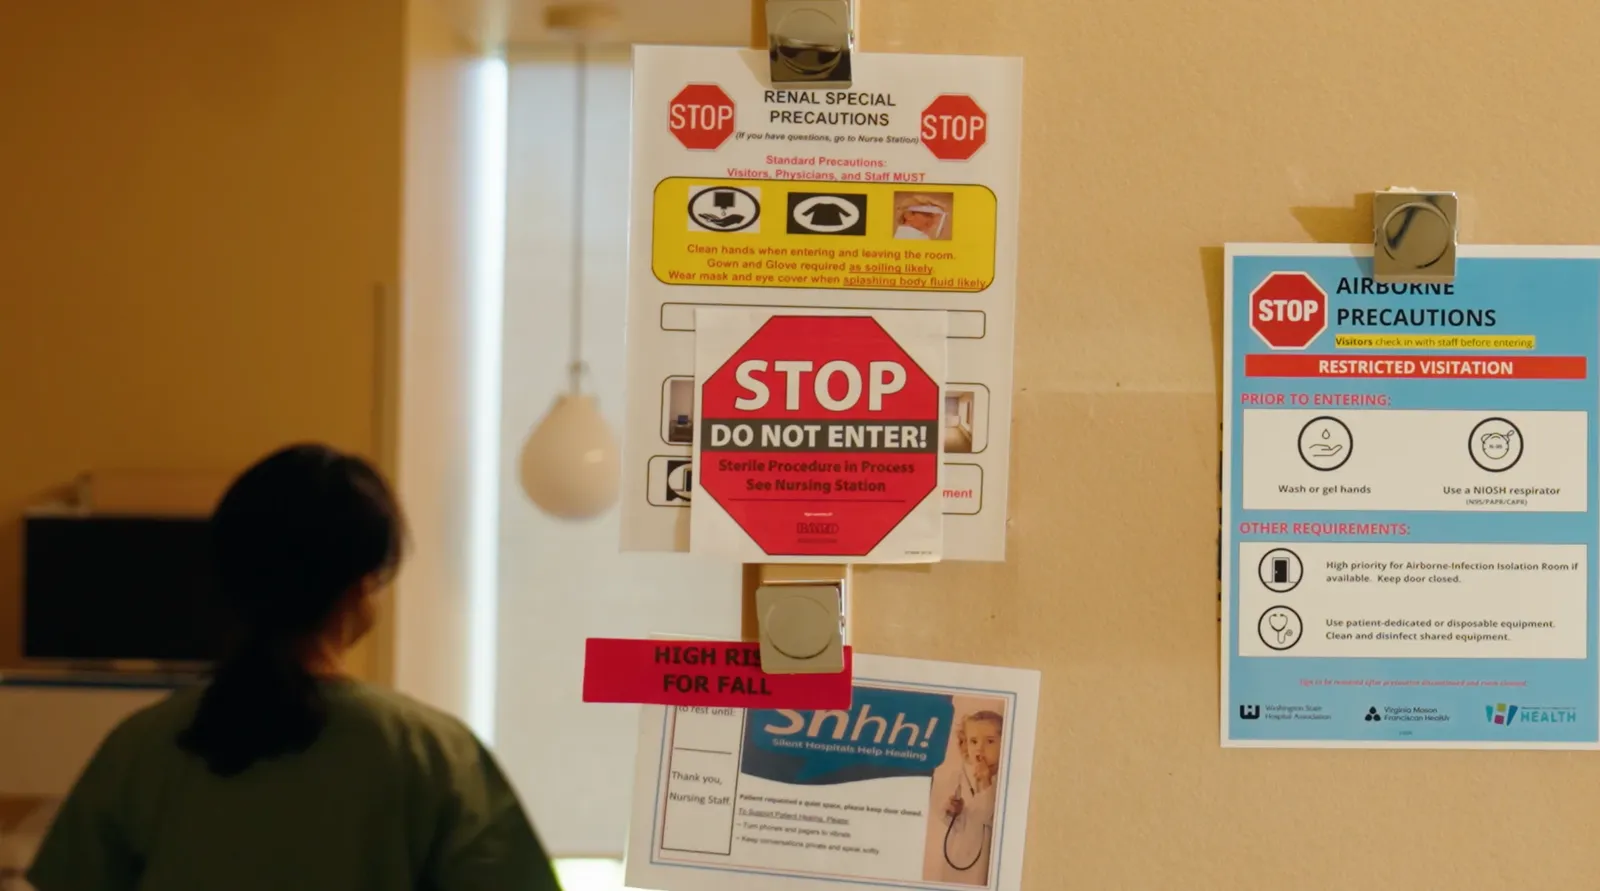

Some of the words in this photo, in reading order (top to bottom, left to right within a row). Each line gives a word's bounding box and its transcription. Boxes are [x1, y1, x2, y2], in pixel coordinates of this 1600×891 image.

[764, 90, 819, 105] RENAL
[825, 92, 896, 106] SPECIAL
[670, 104, 734, 130] STOP
[770, 110, 889, 126] PRECAUTIONS
[922, 114, 985, 141] STOP
[736, 132, 745, 140] (If
[764, 132, 785, 140] have
[788, 133, 832, 142] questions,
[858, 135, 884, 143] Nurse
[886, 135, 919, 144] Station)
[766, 156, 815, 166] Standard
[819, 156, 887, 168] Precautions:
[727, 168, 772, 179] Visitors,
[776, 169, 838, 181] Physicians,
[841, 172, 860, 181] and
[864, 172, 890, 181] Staff
[894, 172, 926, 182] MUST
[687, 244, 718, 254] Clean
[722, 244, 755, 255] hands
[758, 246, 788, 256] when
[791, 246, 834, 258] entering
[838, 249, 858, 258] and
[862, 249, 900, 260] leaving
[904, 250, 921, 258] the
[925, 252, 956, 260] room.
[707, 258, 738, 268] Gown
[742, 259, 762, 268] and
[766, 260, 797, 270] Glove
[800, 261, 846, 272] required
[850, 264, 862, 272] as
[865, 263, 900, 274] soiling
[668, 270, 696, 280] Wear
[700, 271, 728, 281] mask
[732, 272, 752, 282] and
[756, 274, 774, 284] eye
[778, 274, 807, 283] cover
[812, 274, 840, 284] when
[844, 276, 896, 287] splashing
[900, 276, 926, 288] body
[930, 277, 954, 288] fluid
[1336, 277, 1454, 295] AIRBORNE
[1258, 299, 1318, 322] STOP
[1338, 308, 1497, 327] PRECAUTIONS
[1336, 336, 1373, 346] Visitors
[1375, 336, 1401, 346] check
[1404, 338, 1412, 346] in
[1415, 337, 1436, 346] with
[1437, 337, 1458, 347] staff
[1460, 338, 1491, 347] before
[1494, 338, 1534, 348] entering.
[1319, 359, 1415, 374] RESTRICTED
[1420, 360, 1514, 376] VISITATION
[734, 359, 907, 412] STOP
[1241, 393, 1285, 406] PRIOR
[1290, 394, 1310, 406] TO
[1314, 394, 1392, 406] ENTERING:
[711, 424, 754, 448] DO
[761, 424, 821, 448] NOT
[828, 425, 928, 448] ENTER!
[718, 459, 765, 472] Sterile
[768, 460, 840, 473] Procedure
[844, 460, 858, 473] in
[861, 460, 914, 474] Process
[746, 478, 772, 491] See
[775, 479, 831, 493] Nursing
[834, 480, 886, 492] Station
[1278, 484, 1306, 494] Wash
[1322, 484, 1338, 496] gel
[1340, 485, 1372, 494] hands
[1443, 486, 1462, 495] Use
[1473, 486, 1506, 495] NIOSH
[1510, 486, 1561, 496] respirator
[1239, 522, 1289, 535] OTHER
[1292, 522, 1410, 537] REQUIREMENTS:
[1326, 561, 1348, 571] High
[1350, 562, 1387, 572] priority
[1390, 562, 1404, 570] for
[1406, 562, 1494, 570] Airborne-Infection
[1497, 562, 1539, 571] Isolation
[1542, 562, 1570, 571] Room
[1571, 562, 1578, 571] if
[1326, 574, 1372, 583] available.
[1377, 575, 1402, 584] Keep
[1404, 575, 1426, 584] door
[1428, 575, 1462, 584] closed.
[1326, 619, 1344, 628] Use
[1346, 619, 1432, 630] patient-dedicated
[1447, 620, 1498, 630] disposable
[1500, 620, 1556, 630] equipment.
[1326, 632, 1352, 640] Clean
[1355, 632, 1374, 640] and
[1376, 632, 1418, 641] disinfect
[1420, 632, 1454, 641] shared
[1456, 633, 1512, 642] equipment.
[655, 646, 716, 666] HIGH
[725, 648, 762, 668] RIS
[663, 674, 710, 694] FOR
[718, 676, 772, 696] FALL
[691, 706, 709, 715] rest
[1520, 711, 1576, 722] HEALTH
[772, 738, 803, 748] Silent
[806, 742, 855, 754] Hospitals
[858, 746, 883, 756] Help
[886, 748, 928, 760] Healing
[672, 771, 700, 782] Thank
[703, 775, 722, 785] you,
[670, 792, 706, 806] Nursing
